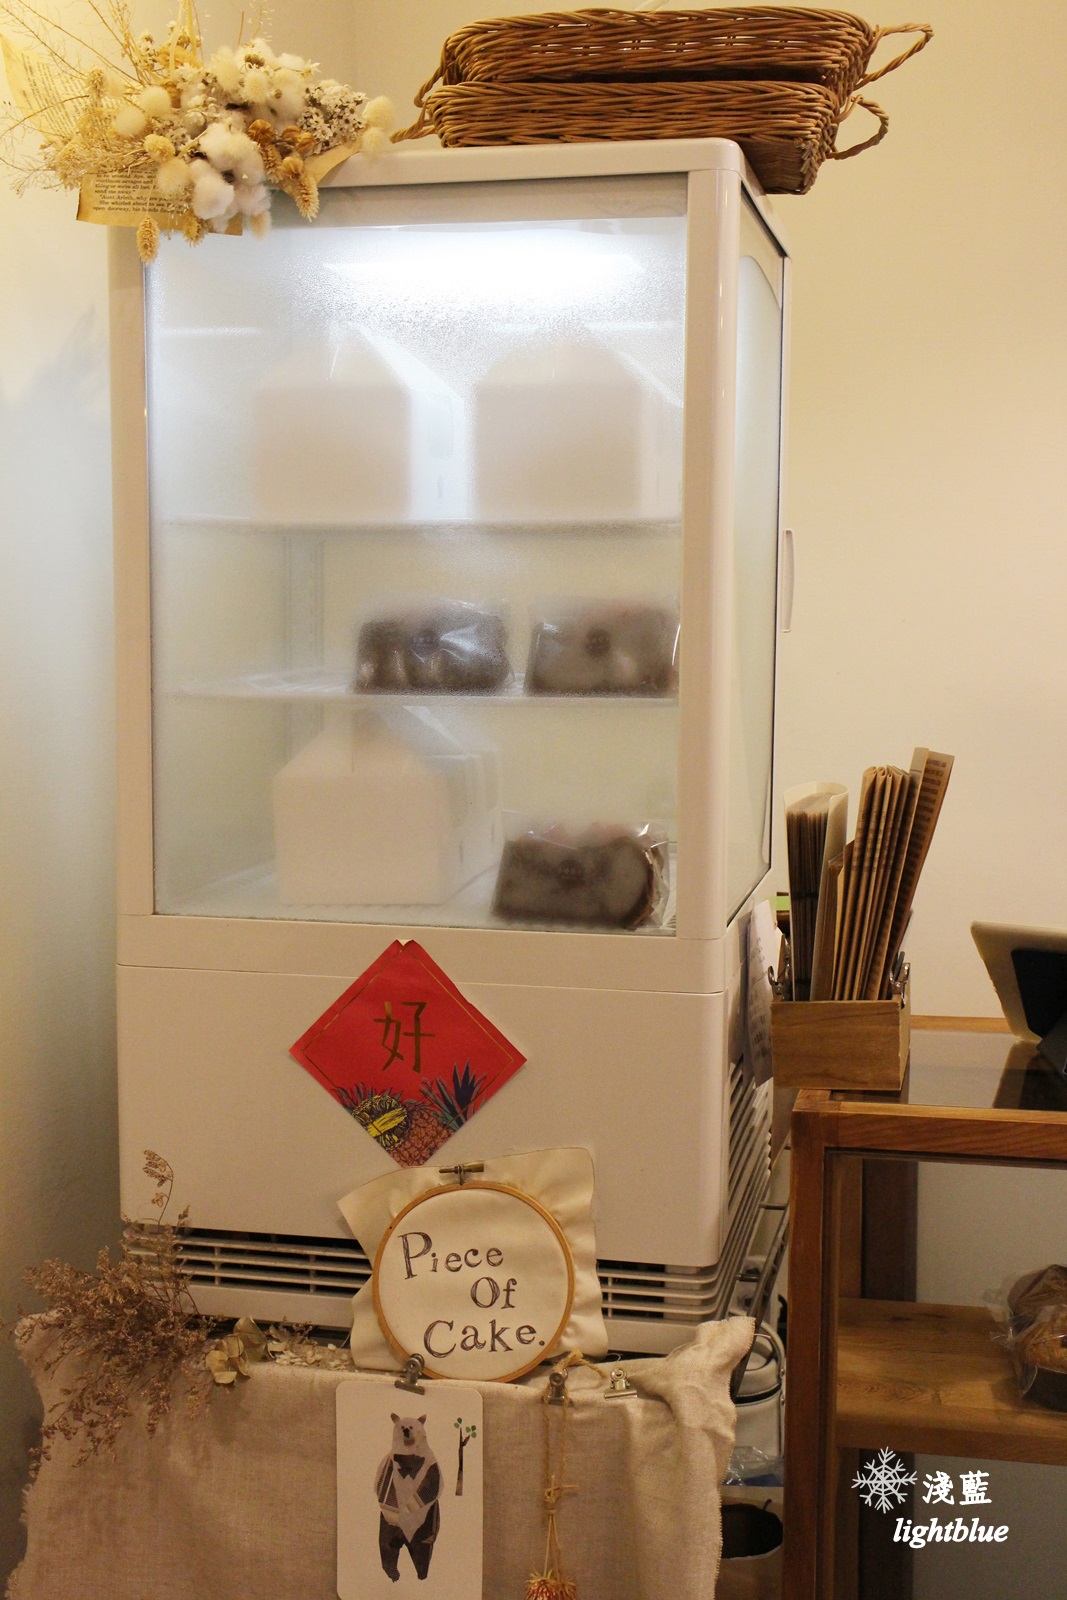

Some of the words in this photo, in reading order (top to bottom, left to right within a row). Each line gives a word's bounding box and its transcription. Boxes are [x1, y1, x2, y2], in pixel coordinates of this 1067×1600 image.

[373, 1001, 435, 1074] 好
[397, 1231, 504, 1279] Piece
[470, 1276, 518, 1309] Of
[423, 1319, 546, 1359] Cake.
